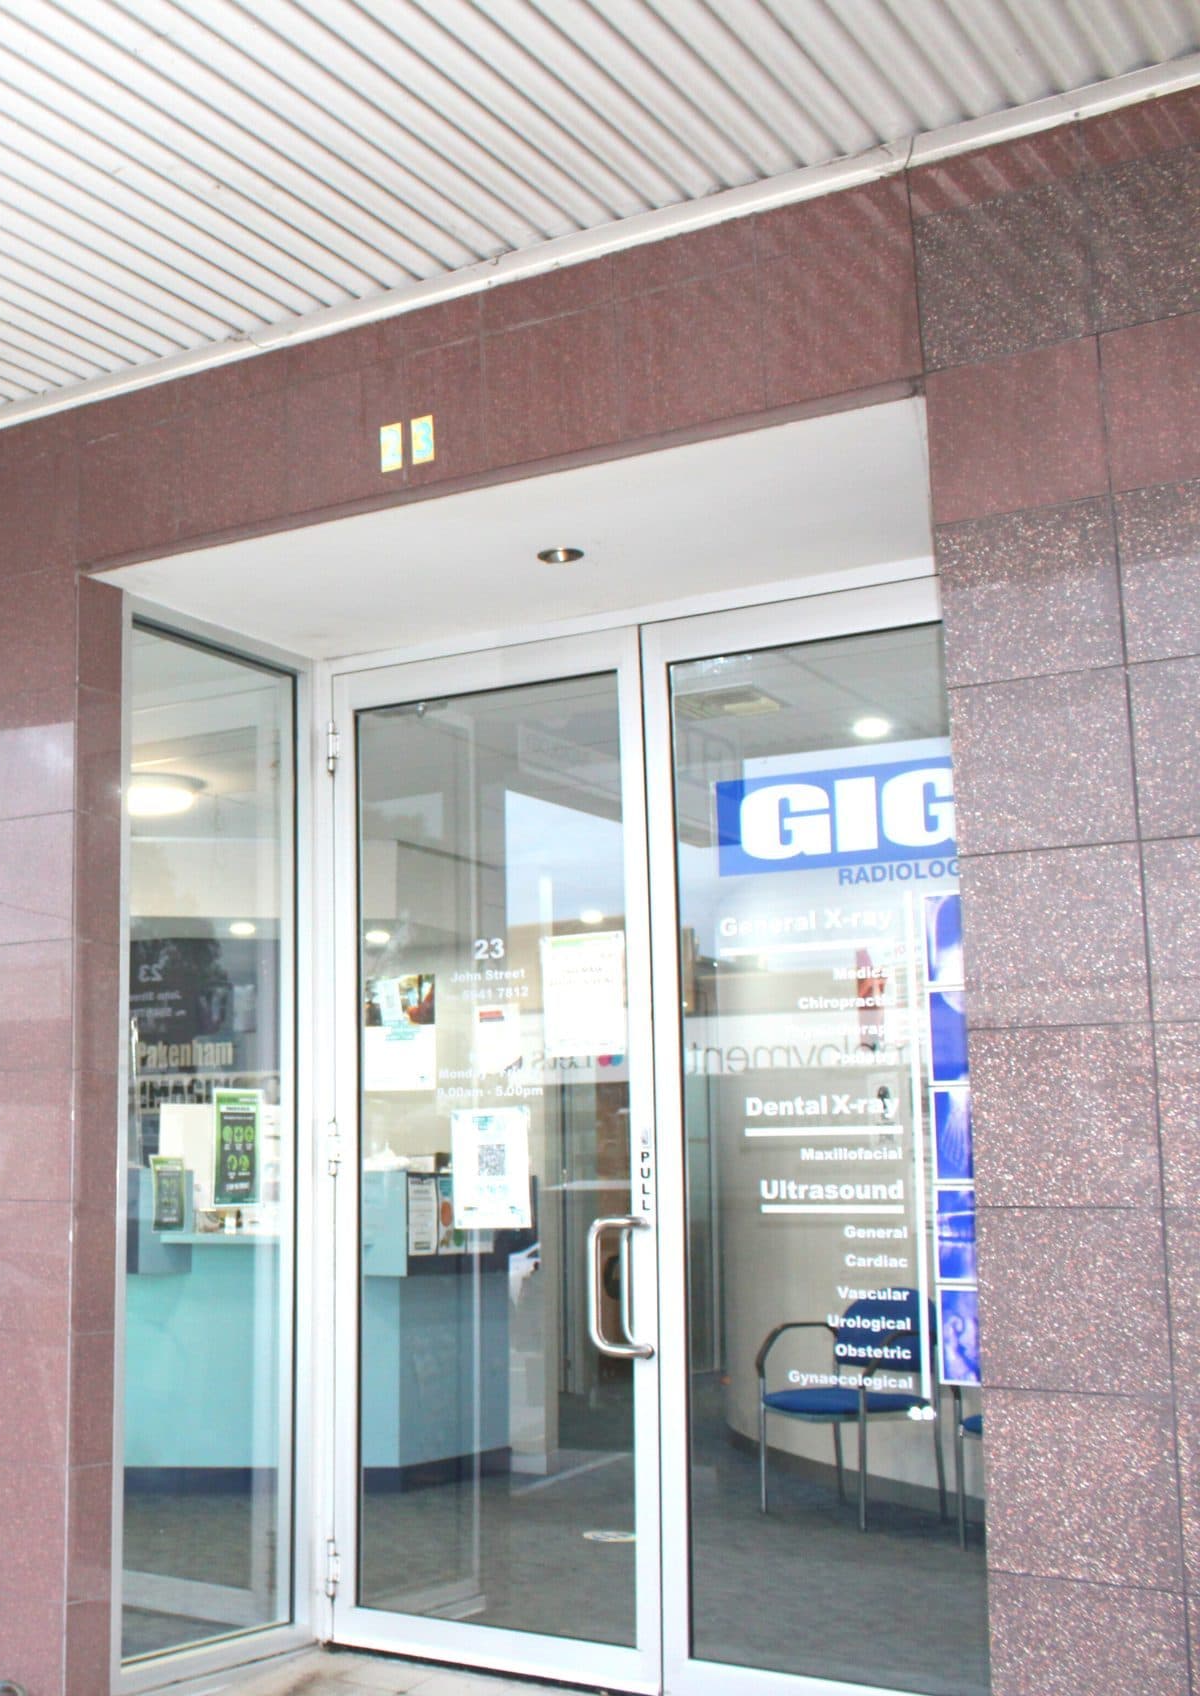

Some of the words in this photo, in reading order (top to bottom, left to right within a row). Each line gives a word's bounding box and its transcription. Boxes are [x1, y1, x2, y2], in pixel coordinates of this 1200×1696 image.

[740, 768, 956, 860] GIG
[720, 909, 816, 937] General
[824, 907, 893, 932] X-ray
[474, 938, 505, 960] 23
[451, 971, 482, 984] John
[485, 968, 526, 982] Street
[136, 1038, 234, 1069] Pakenham
[746, 1094, 828, 1117] Dental
[832, 1094, 901, 1118] X-ray
[801, 1147, 903, 1161] Maxillofacial
[640, 1151, 650, 1211] PULL
[761, 1180, 904, 1201] Ultrasound
[844, 1225, 908, 1240] General
[845, 1254, 909, 1269] Cardiac
[837, 1286, 910, 1301] Vascular
[827, 1314, 911, 1333] Urological
[835, 1344, 912, 1360] Obstetric
[788, 1369, 913, 1390] Gynaecological
